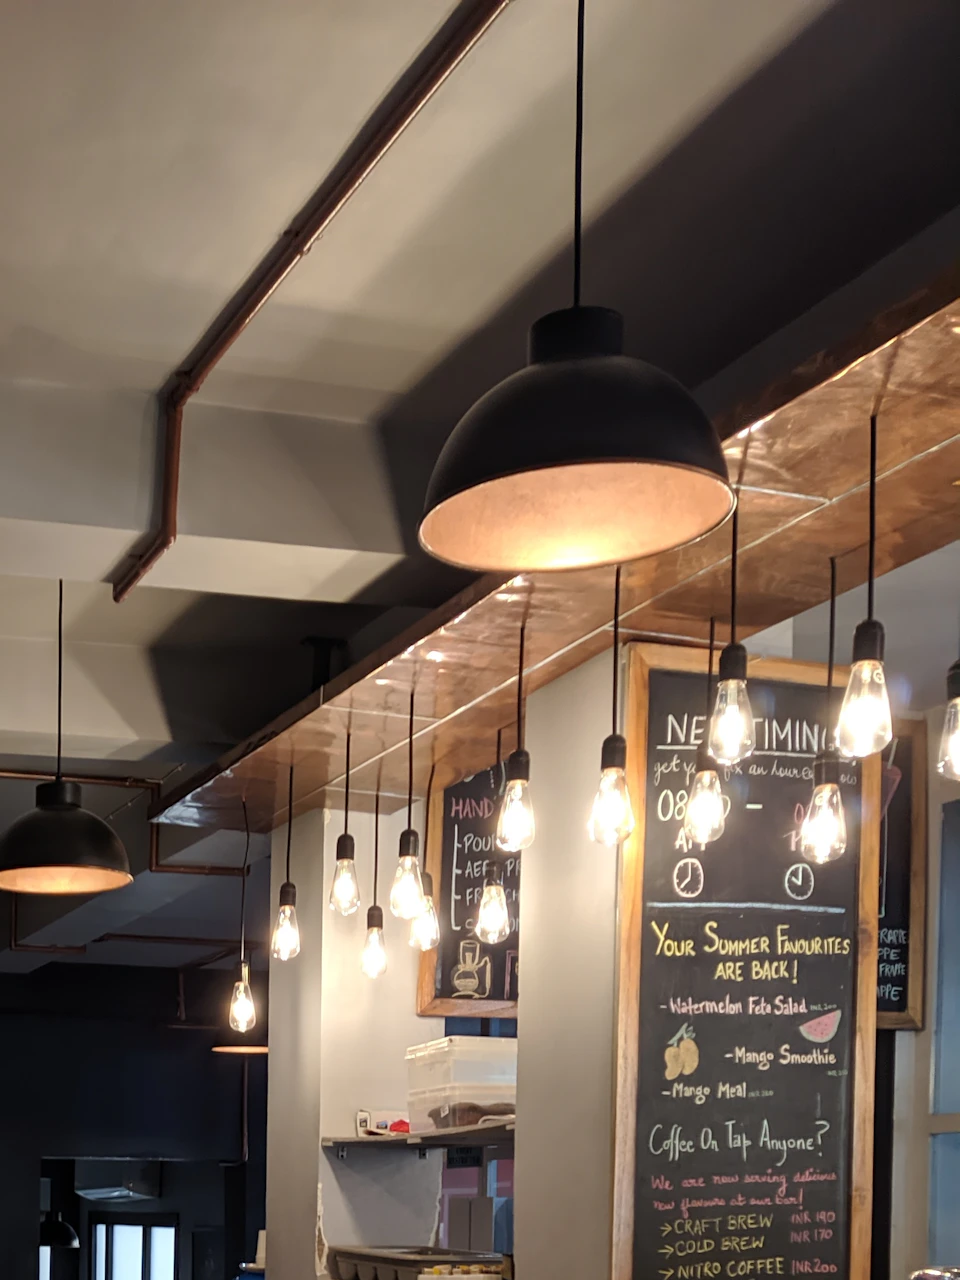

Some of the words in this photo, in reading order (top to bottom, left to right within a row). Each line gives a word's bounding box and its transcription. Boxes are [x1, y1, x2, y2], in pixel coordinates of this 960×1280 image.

[654, 753, 681, 785] get
[714, 961, 744, 980] ARE
[751, 959, 799, 984] BACK!
[749, 997, 772, 1015] Feta
[774, 995, 808, 1016] Salad
[779, 1044, 837, 1065] Smoothie
[717, 1081, 747, 1099] Meal
[649, 1123, 695, 1161] Coffee
[701, 1127, 719, 1152] On
[724, 1120, 752, 1162] Tap
[759, 1118, 830, 1166] Anyone?
[651, 1175, 673, 1190] We
[681, 1176, 706, 1188] are
[744, 1168, 788, 1196] serving
[730, 1193, 747, 1207] at
[674, 1217, 722, 1236] CRAFT
[727, 1213, 774, 1231] BREW
[791, 1212, 811, 1225] INR
[816, 1211, 836, 1224] 190
[675, 1239, 715, 1256] COLD
[721, 1235, 765, 1253] BREW
[790, 1230, 810, 1243] INR
[814, 1229, 833, 1241] 170
[677, 1261, 722, 1279] NITRO
[726, 1257, 785, 1277] COFFEE
[791, 1259, 811, 1276] INR
[814, 1259, 837, 1273] 200
